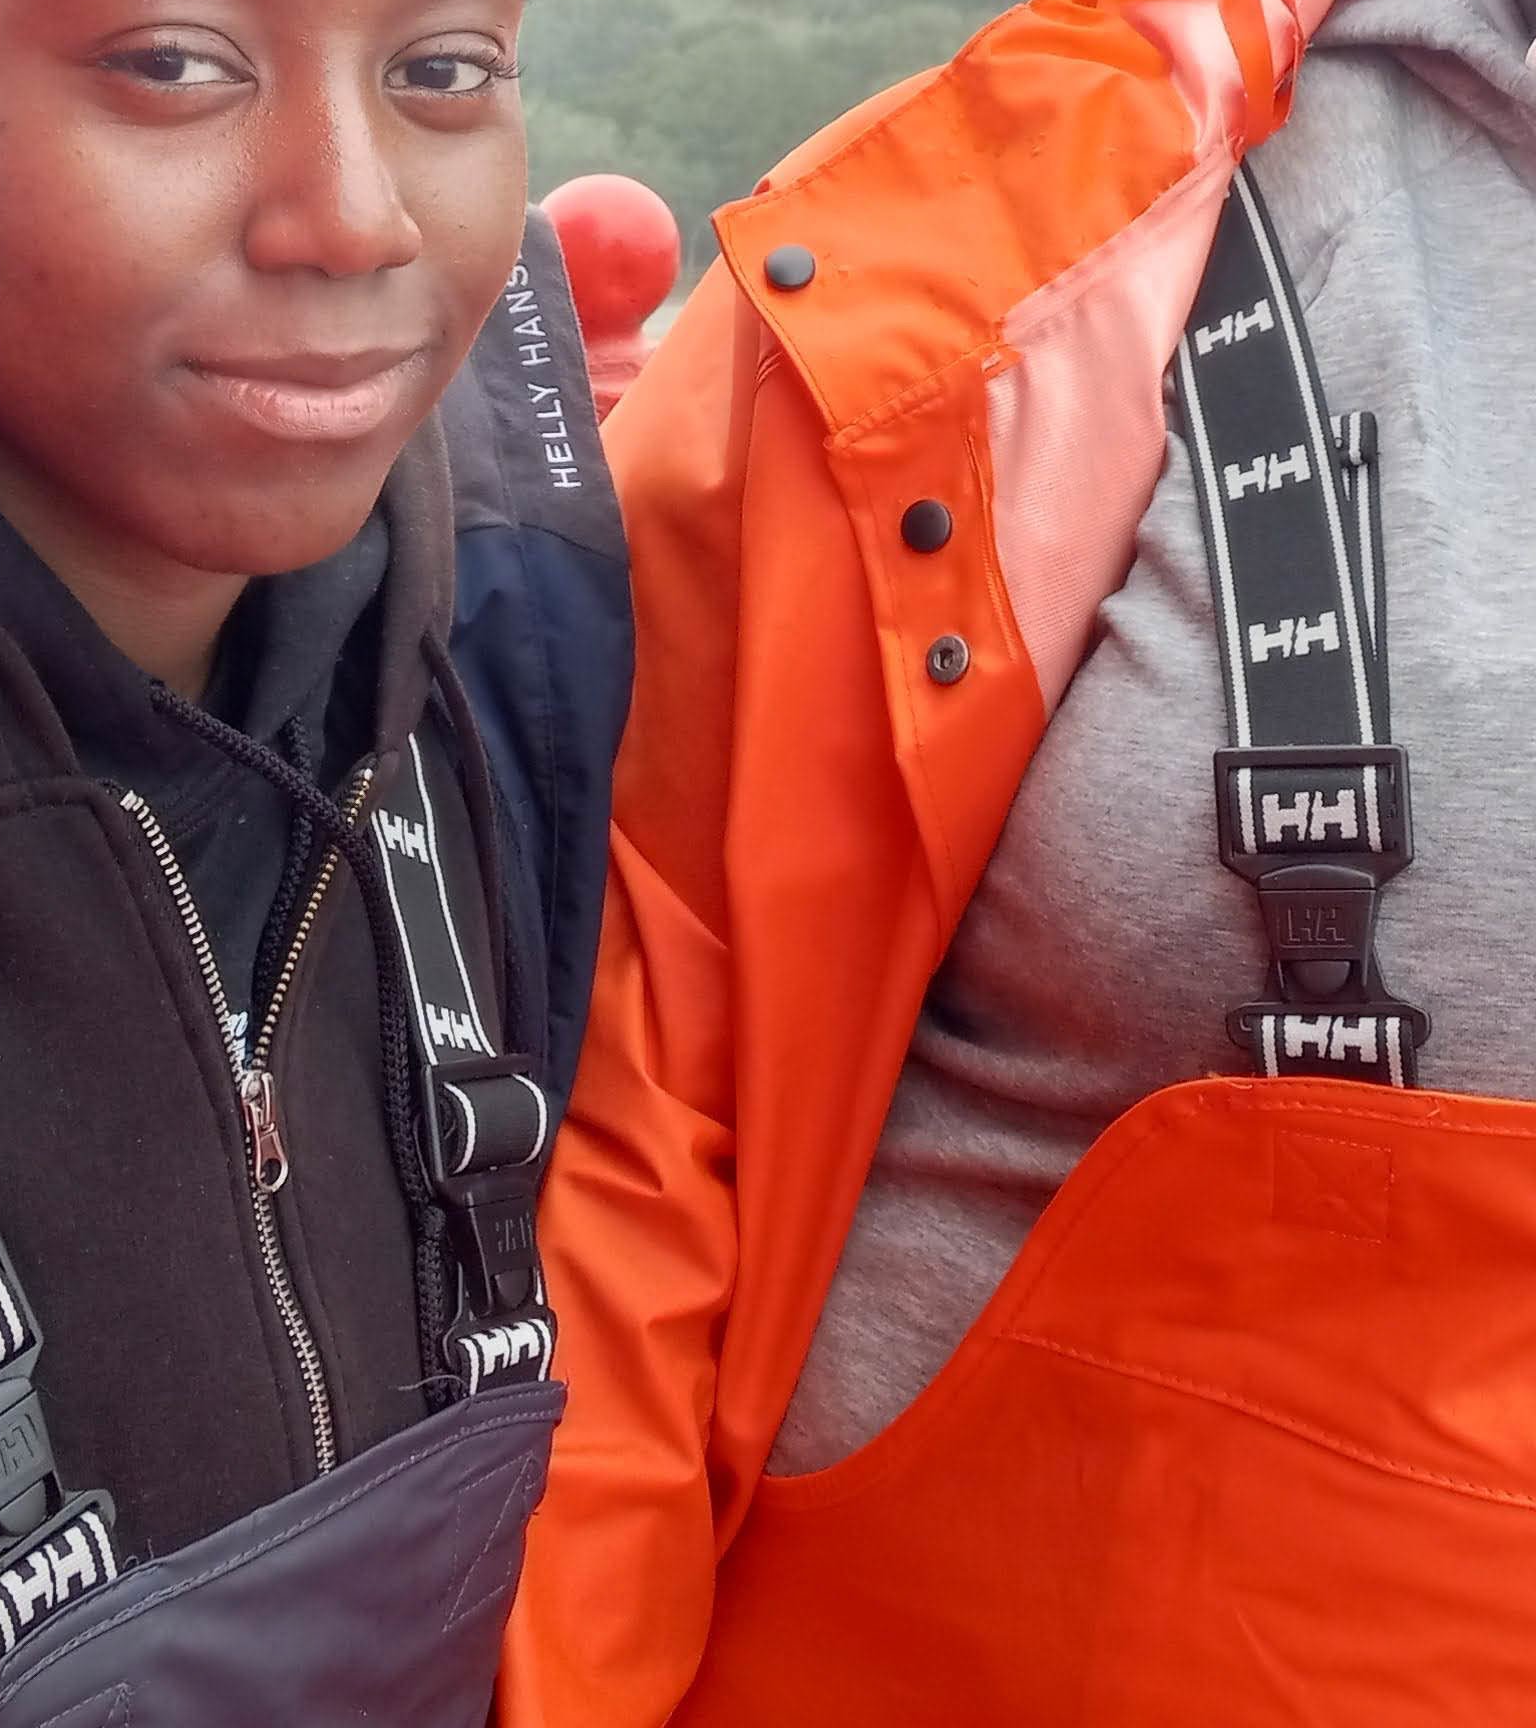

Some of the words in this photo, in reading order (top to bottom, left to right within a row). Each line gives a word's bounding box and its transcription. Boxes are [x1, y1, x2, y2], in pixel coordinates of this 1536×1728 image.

[505, 254, 552, 367] HANS
[1195, 299, 1274, 355] HH
[526, 383, 582, 489] HELLY
[1224, 445, 1310, 500] HH
[1249, 611, 1339, 662] HH
[379, 809, 429, 864] HH
[1262, 789, 1358, 842] HH
[426, 1003, 482, 1052] HH
[1284, 1015, 1377, 1062] HH
[471, 1322, 540, 1376] HH
[0, 1526, 96, 1625] HH
